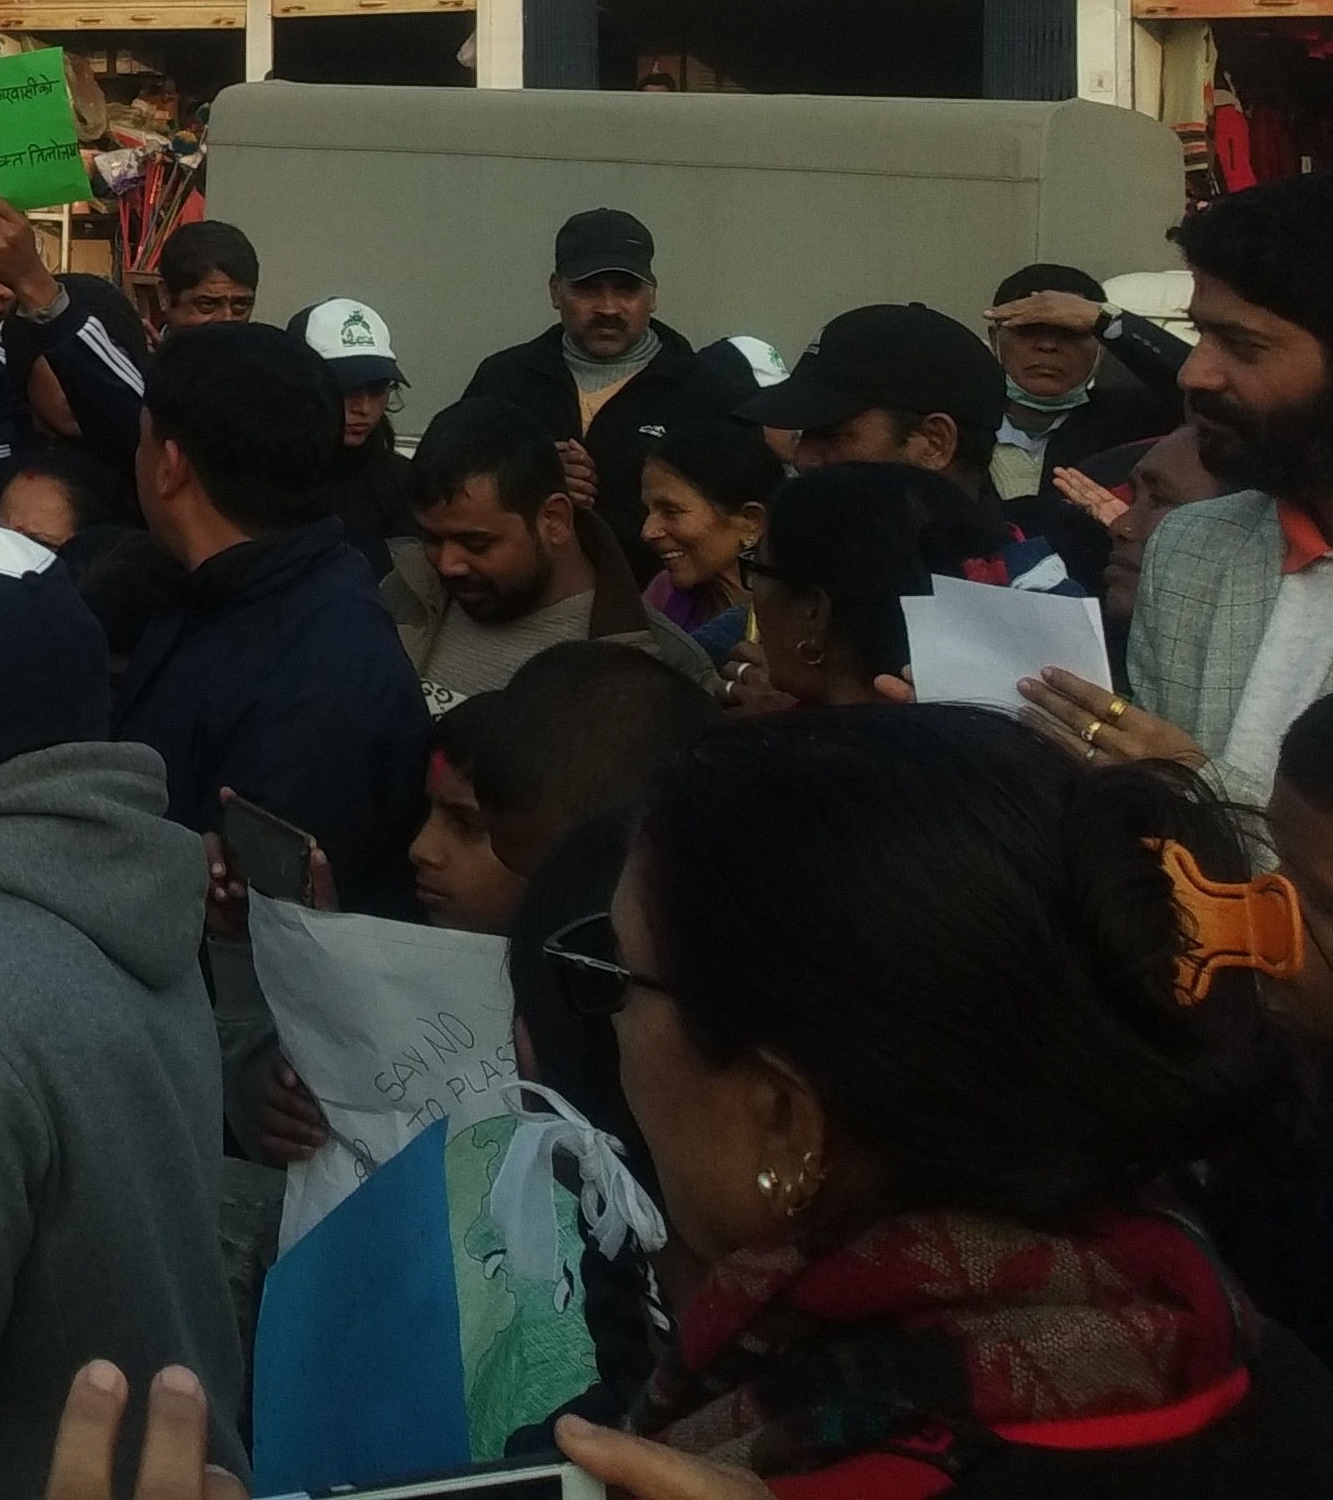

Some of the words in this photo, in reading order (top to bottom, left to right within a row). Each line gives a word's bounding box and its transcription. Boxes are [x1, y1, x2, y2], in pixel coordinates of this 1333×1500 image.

[374, 1045, 429, 1103] SAY
[416, 1011, 476, 1065] NO
[406, 1098, 446, 1131] TO
[445, 1040, 520, 1105] PLAS
